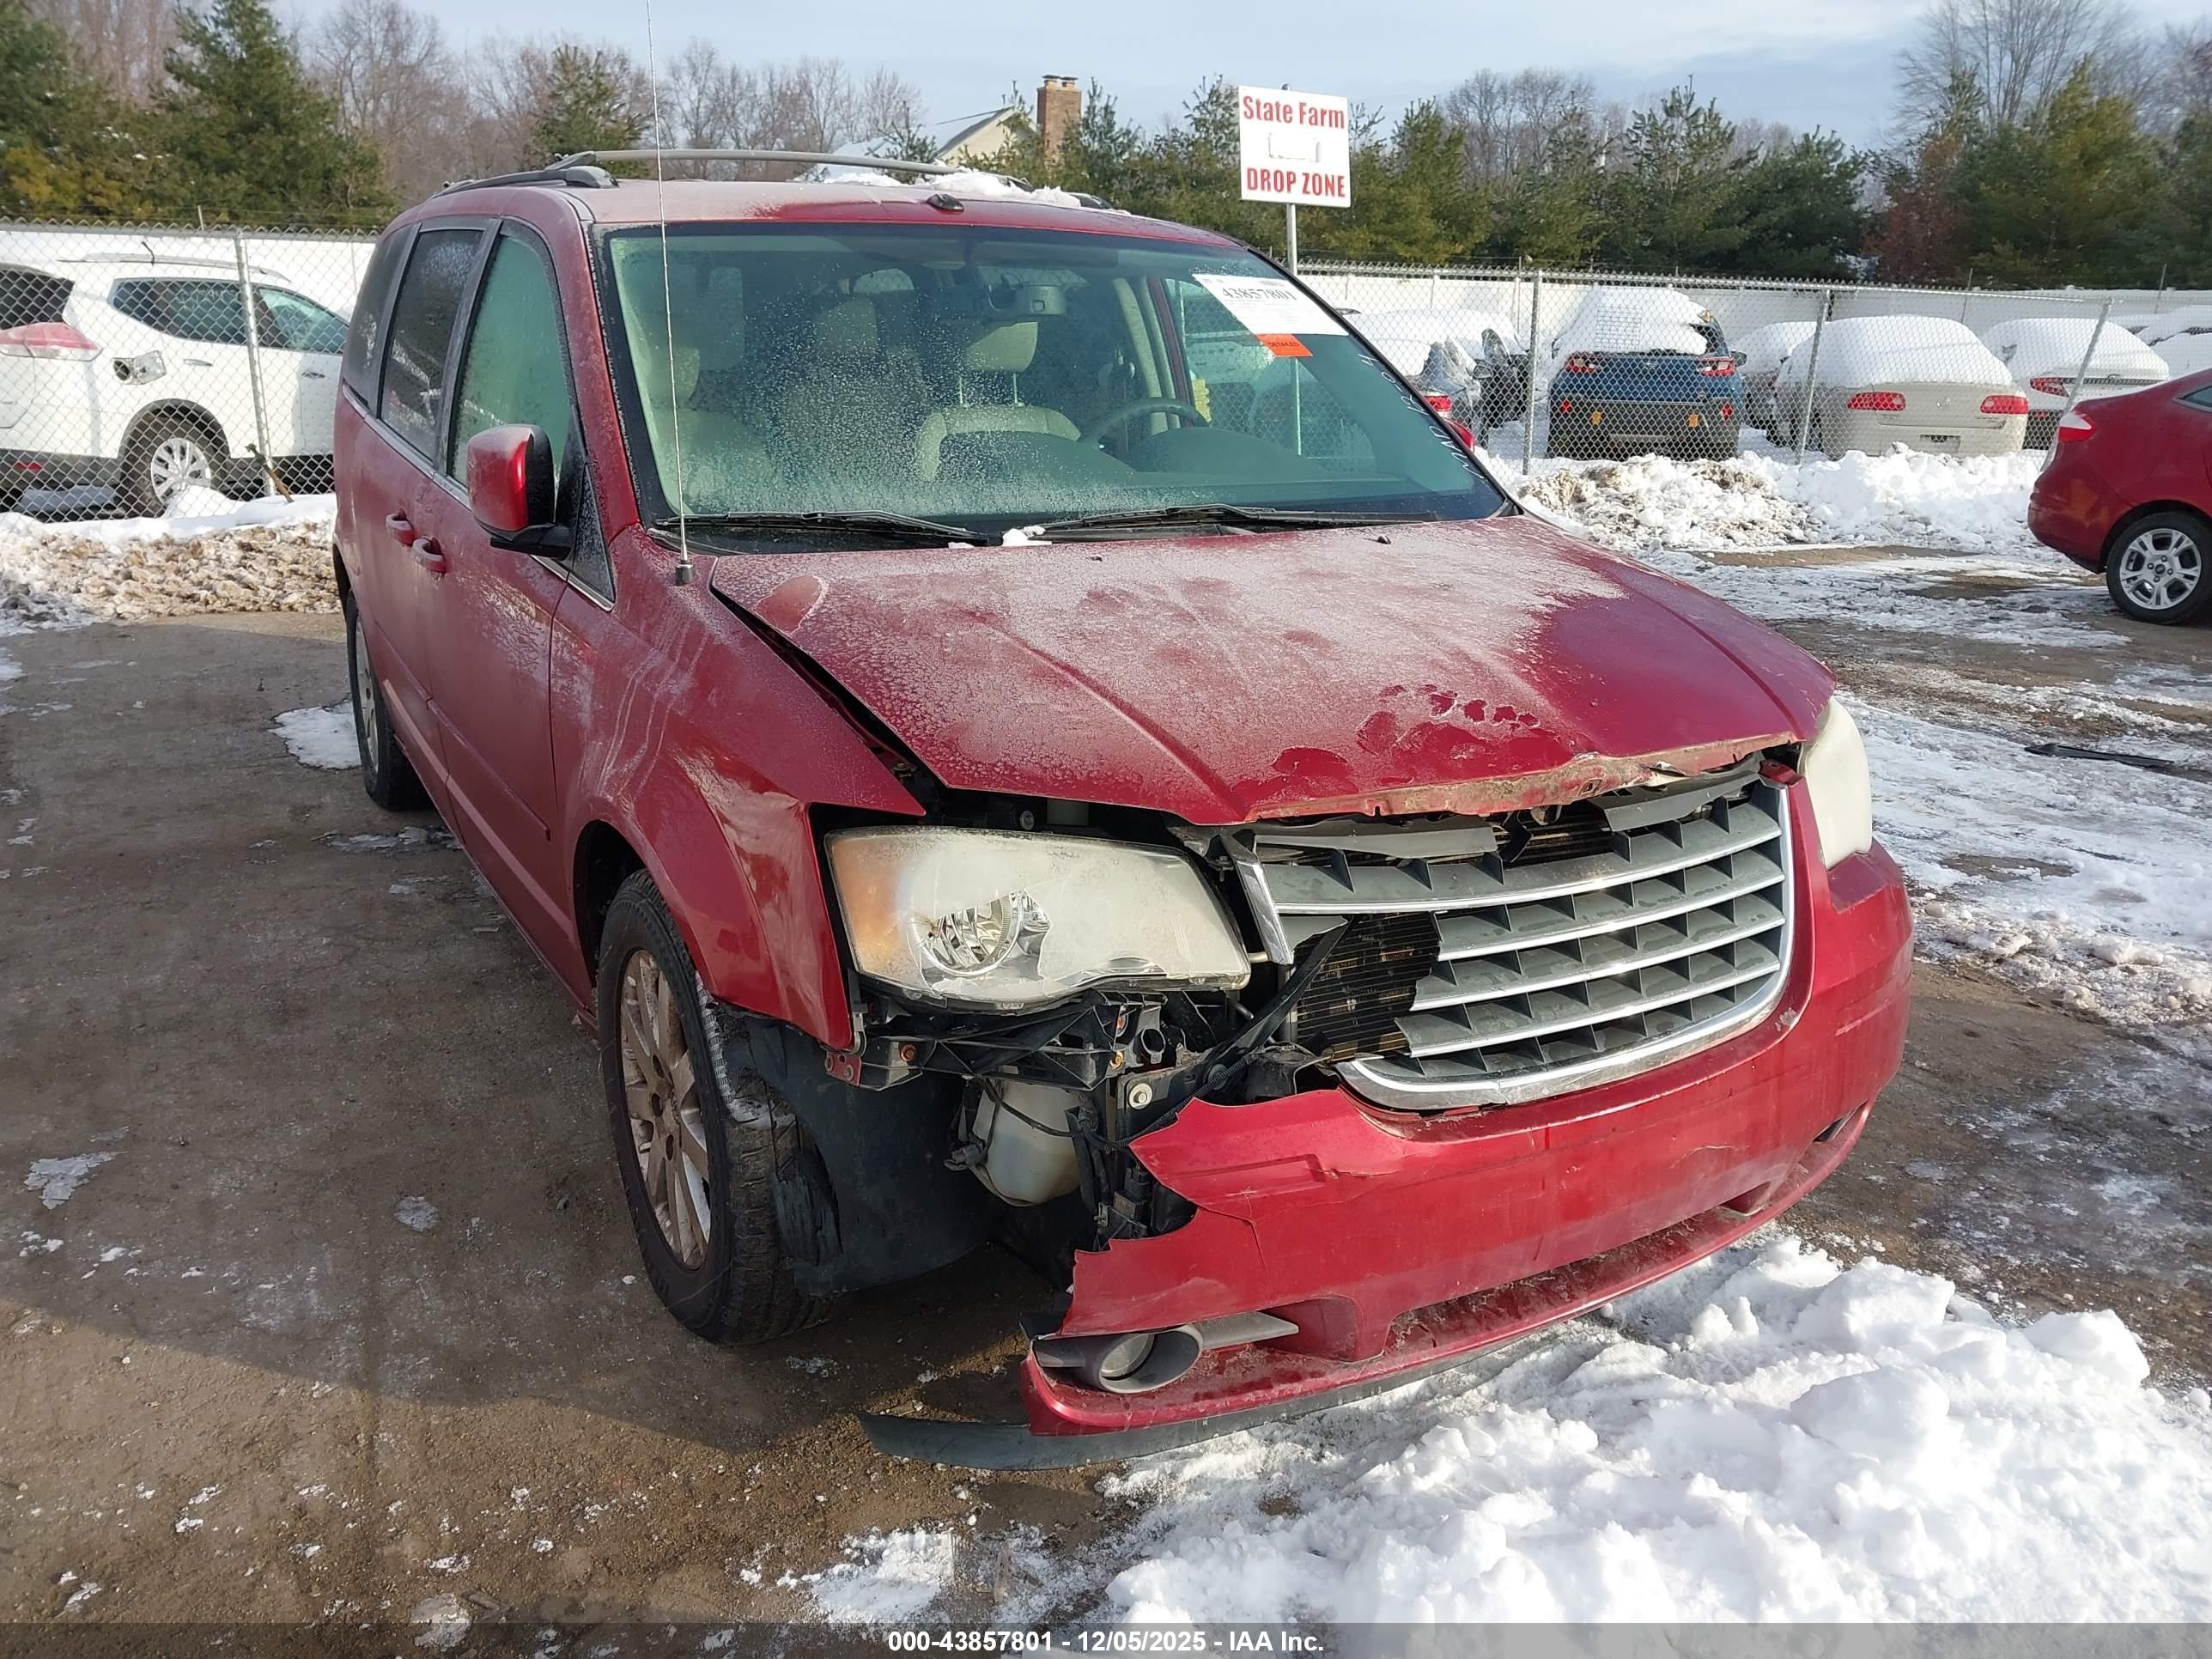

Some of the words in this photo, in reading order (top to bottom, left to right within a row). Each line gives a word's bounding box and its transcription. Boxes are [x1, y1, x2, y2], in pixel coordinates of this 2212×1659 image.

[1243, 95, 1293, 124] State
[1298, 102, 1345, 129] Farm
[1246, 167, 1297, 193] DROP
[1302, 172, 1346, 198] ZONE
